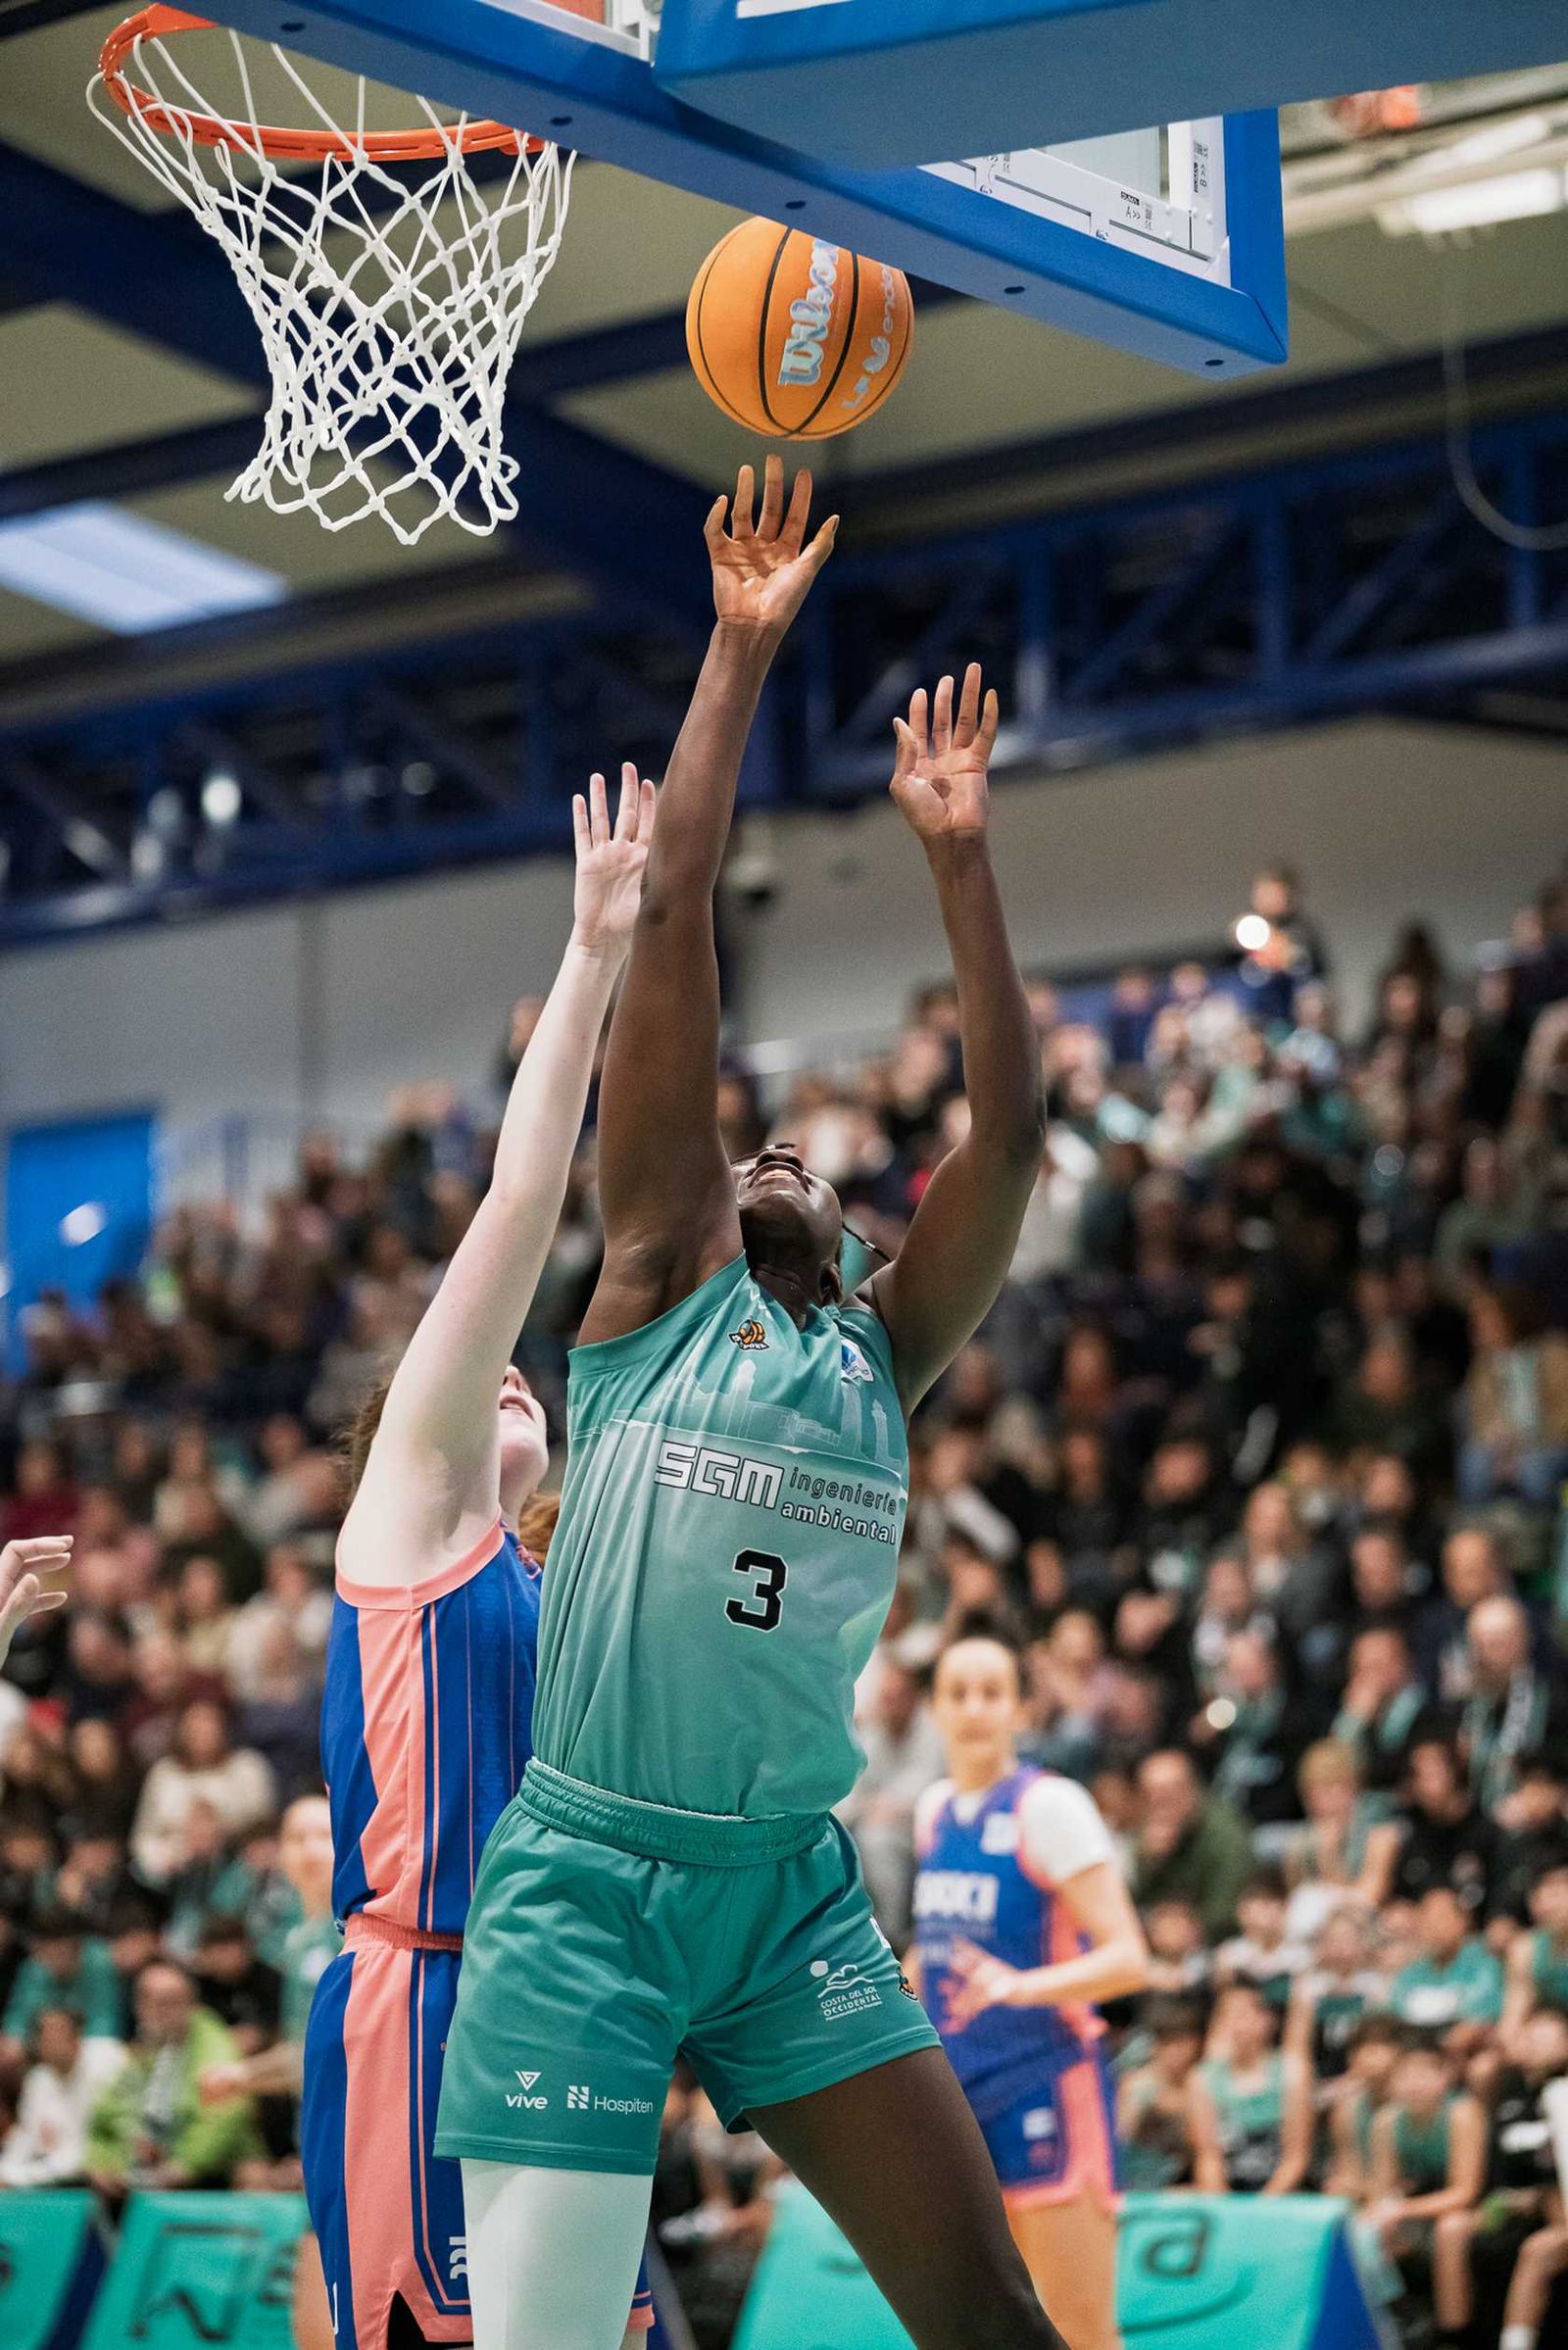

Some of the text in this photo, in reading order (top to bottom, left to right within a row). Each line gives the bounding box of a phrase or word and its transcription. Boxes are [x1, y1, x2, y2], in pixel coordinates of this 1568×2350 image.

[777, 238, 839, 386] Wilson
[654, 1441, 784, 1510] SGM
[781, 1501, 897, 1545] ambiental
[725, 1547, 788, 1633] 3
[820, 1985, 878, 2009] COSTA DEL SOL
[823, 1993, 881, 2017] OCCIDENTAL
[505, 2092, 549, 2110] vive
[594, 2096, 654, 2115] Hospiten
